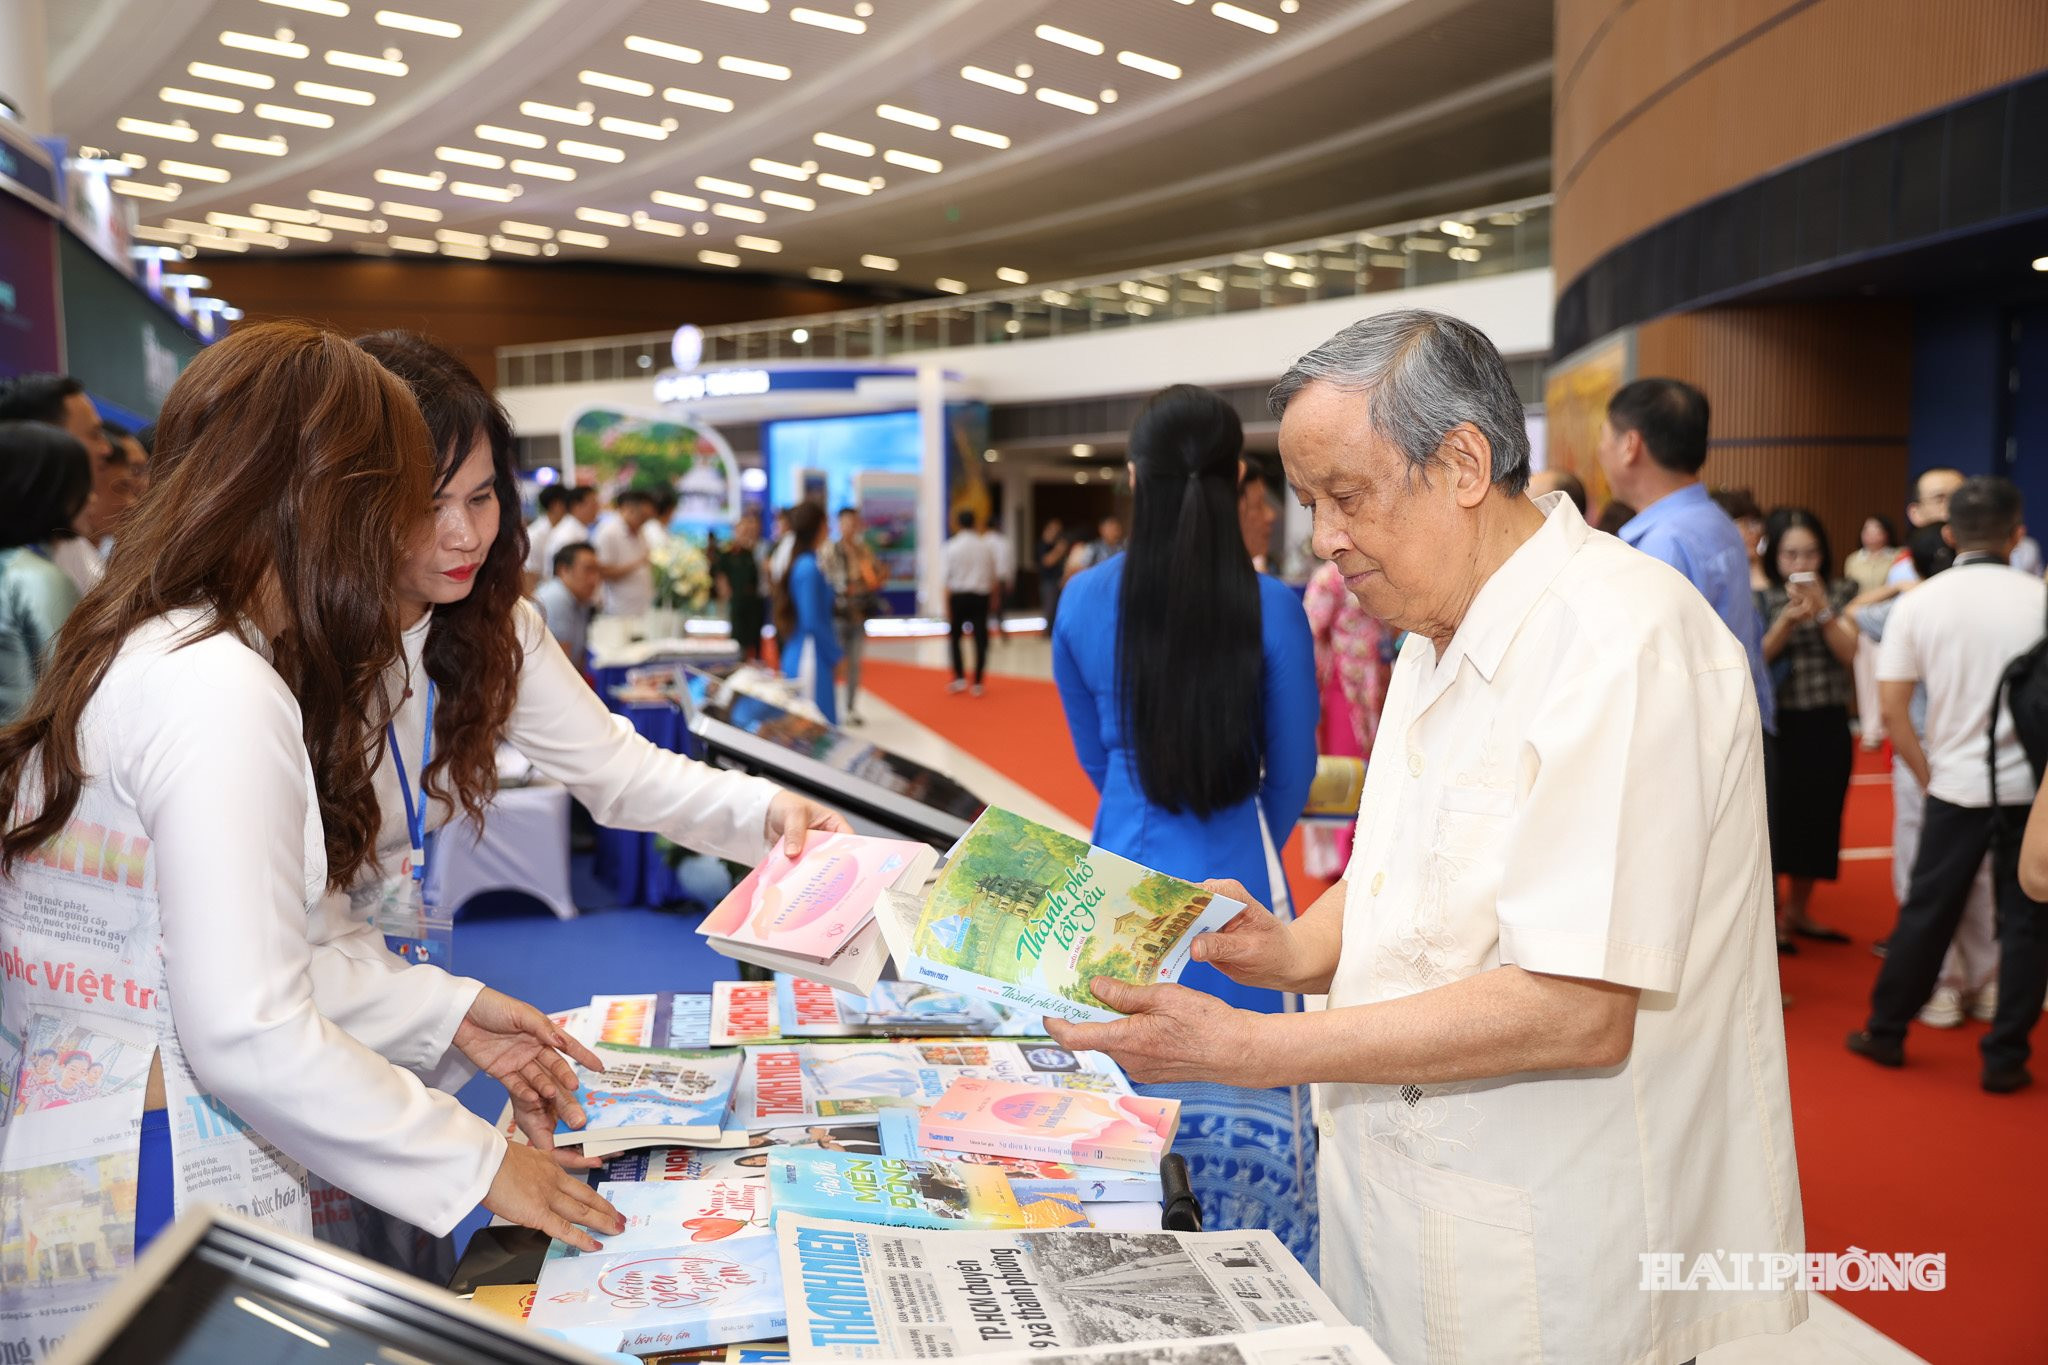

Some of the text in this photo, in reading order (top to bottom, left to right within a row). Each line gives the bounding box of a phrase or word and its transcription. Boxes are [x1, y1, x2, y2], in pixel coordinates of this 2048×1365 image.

[1016, 855, 1095, 961] Thành phố
[1053, 914, 1080, 951] tôi
[43, 961, 116, 1004] Việt
[124, 979, 158, 1010] tr
[1001, 986, 1033, 1004] Thành
[1035, 998, 1056, 1012] phố
[1055, 1002, 1070, 1014] tôi
[275, 1185, 297, 1211] hóa
[880, 1159, 917, 1210] ĐÔNG
[793, 1227, 881, 1347] THANH NIÊN
[947, 1260, 1014, 1341] TP.HCM chuyển
[990, 1248, 1061, 1349] 9 xã thành phường
